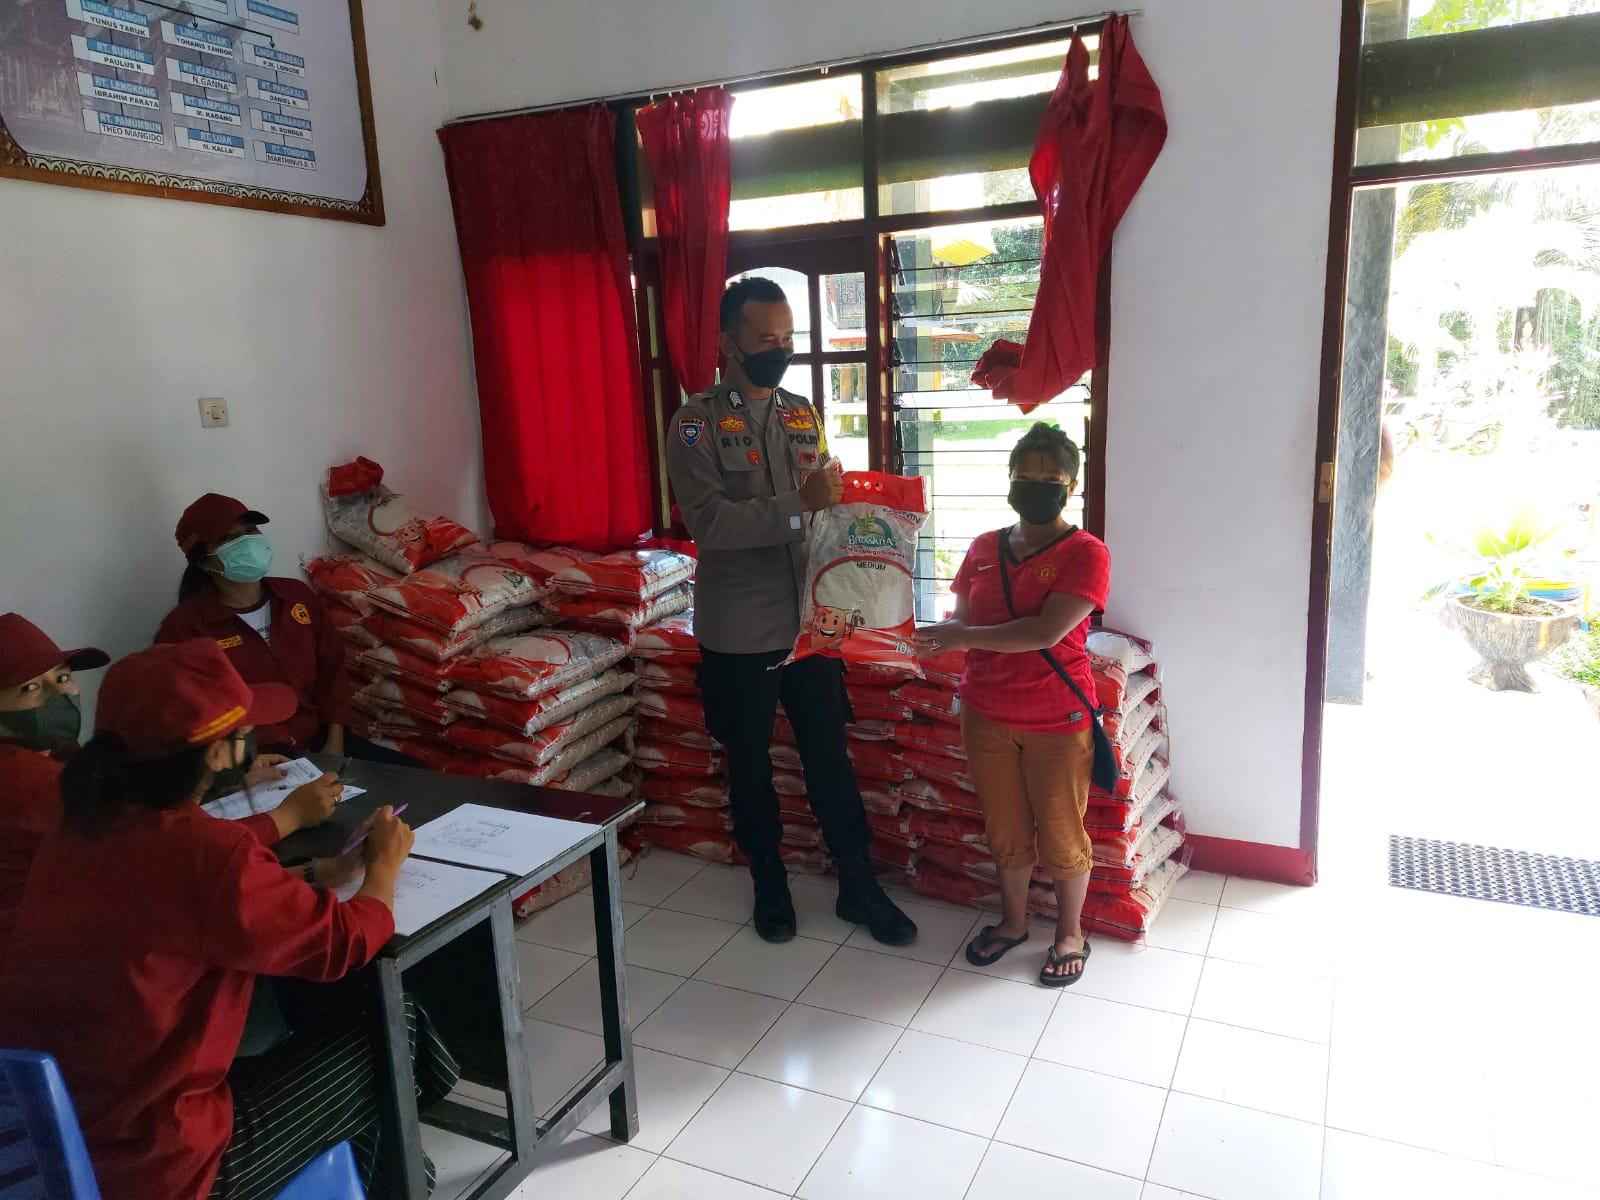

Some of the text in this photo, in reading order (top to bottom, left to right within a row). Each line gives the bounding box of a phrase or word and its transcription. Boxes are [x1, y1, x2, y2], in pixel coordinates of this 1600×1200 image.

[90, 16, 146, 36] YUNUS TARUK
[176, 37, 206, 50] YOHANIS
[104, 57, 135, 68] PAULUS
[95, 89, 159, 108] IBRAHIM PAKATA
[269, 95, 291, 105] DANIEL
[102, 124, 162, 142] THEO MANGIDO
[720, 436, 752, 449] RIO
[789, 433, 818, 446] POLRI
[856, 560, 886, 571] MEDIUM
